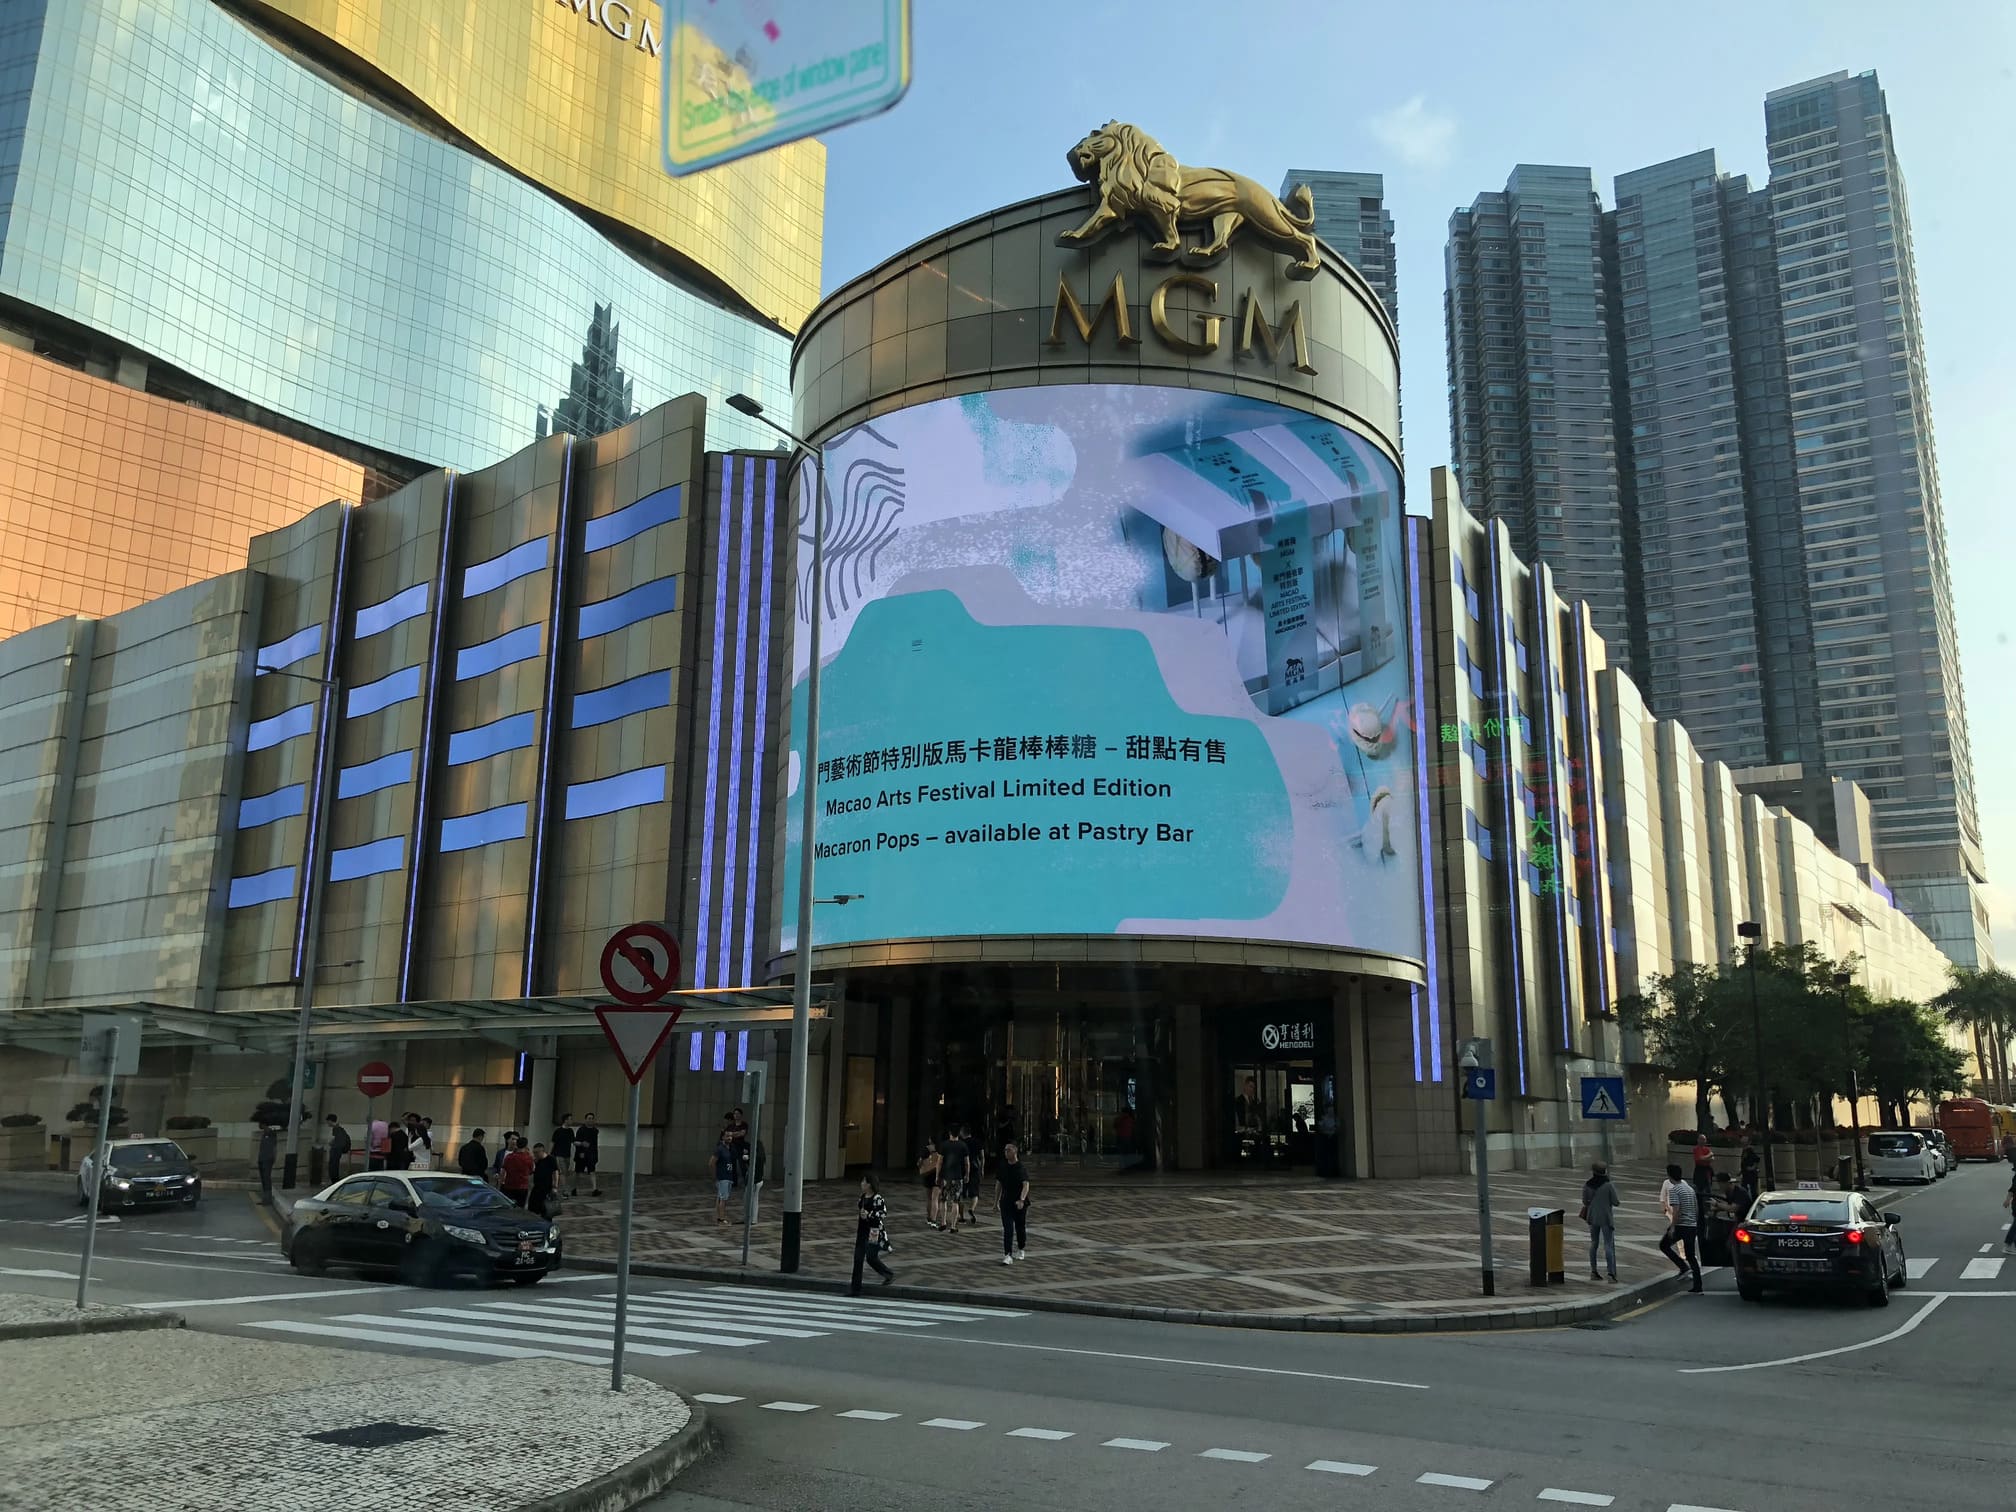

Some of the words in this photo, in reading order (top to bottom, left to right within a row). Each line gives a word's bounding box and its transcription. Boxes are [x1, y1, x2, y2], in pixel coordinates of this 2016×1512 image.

[1042, 268, 1318, 376] MGM
[817, 734, 1097, 785] 門藝術節特別版馬卡龍棒棒糖
[1126, 735, 1226, 764] 甜點有售
[826, 797, 872, 817] Macao
[876, 789, 911, 808] Arts
[918, 781, 995, 803] Festival
[1003, 778, 1085, 798] Limited
[1093, 778, 1171, 797] Edition
[814, 838, 871, 861] Macaron
[876, 832, 920, 851] Pops
[945, 823, 1041, 844] available
[1048, 824, 1070, 841] at
[1078, 821, 1149, 845] Pastry
[1156, 823, 1194, 842] Bar
[1280, 1041, 1314, 1049] HENGDELI
